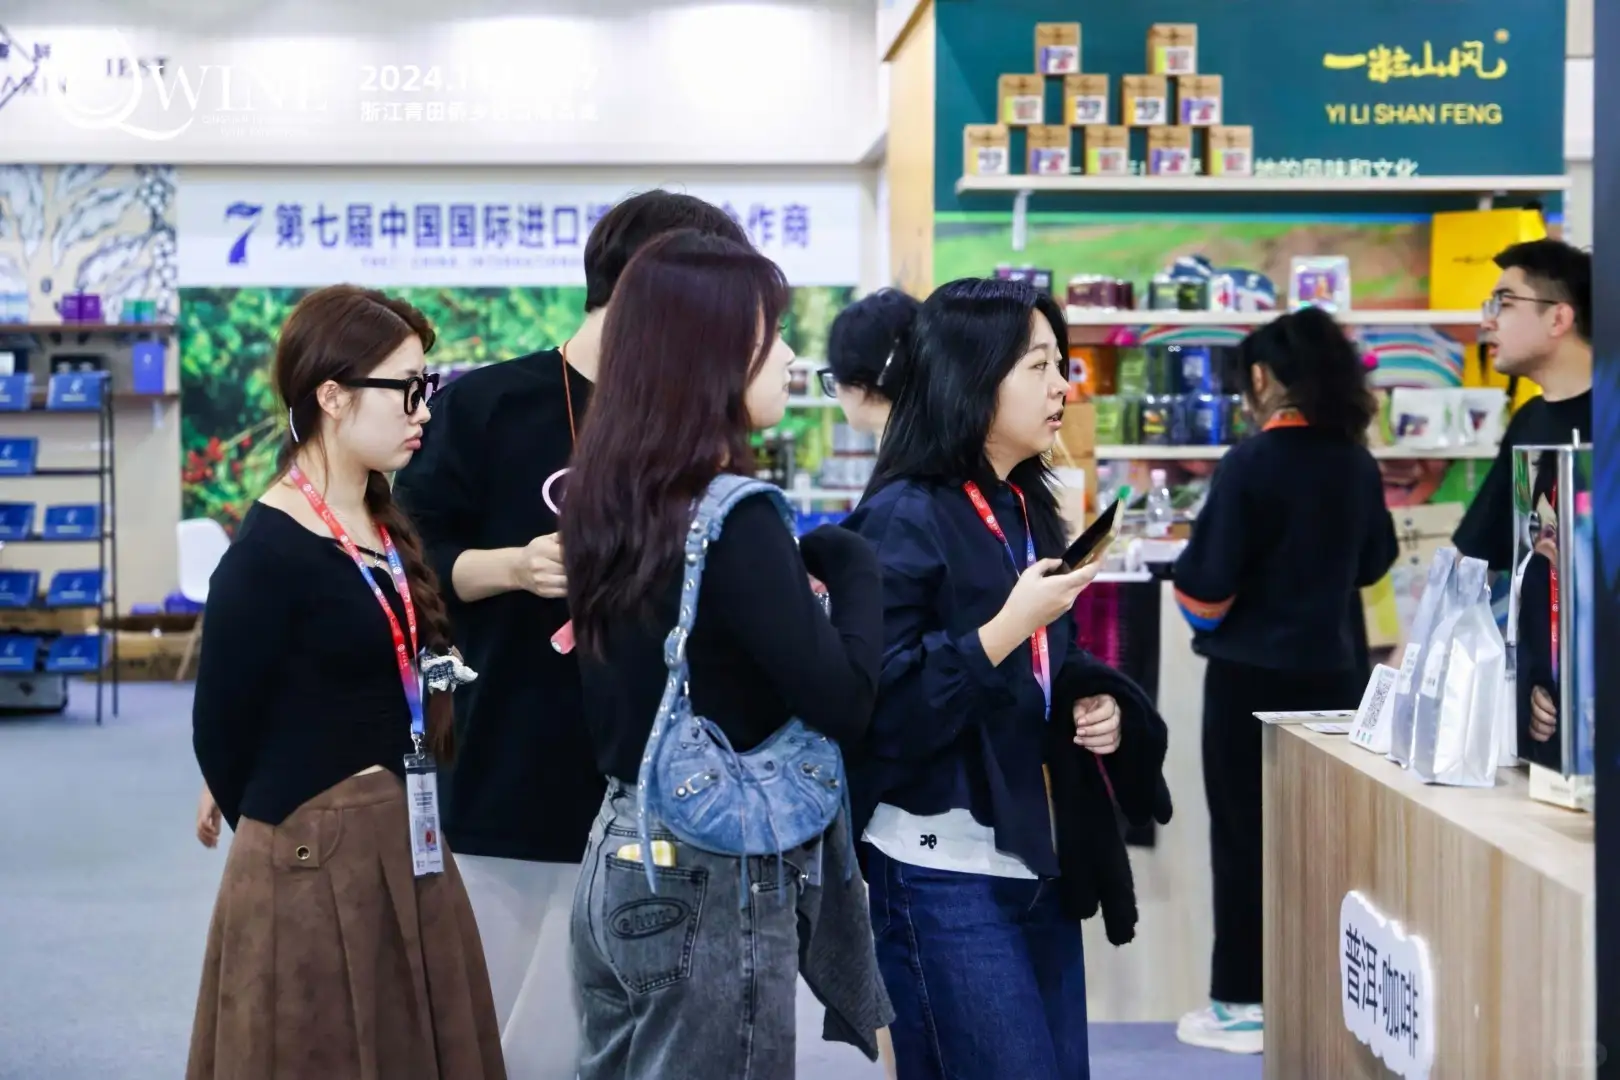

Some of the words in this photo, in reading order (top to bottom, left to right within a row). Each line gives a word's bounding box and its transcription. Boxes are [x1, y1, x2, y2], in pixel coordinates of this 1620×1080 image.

[1325, 103, 1346, 125] YI
[1350, 103, 1370, 125] LI
[1374, 103, 1435, 125] SHAN
[1440, 103, 1503, 125] FENG
[225, 201, 264, 266] 7
